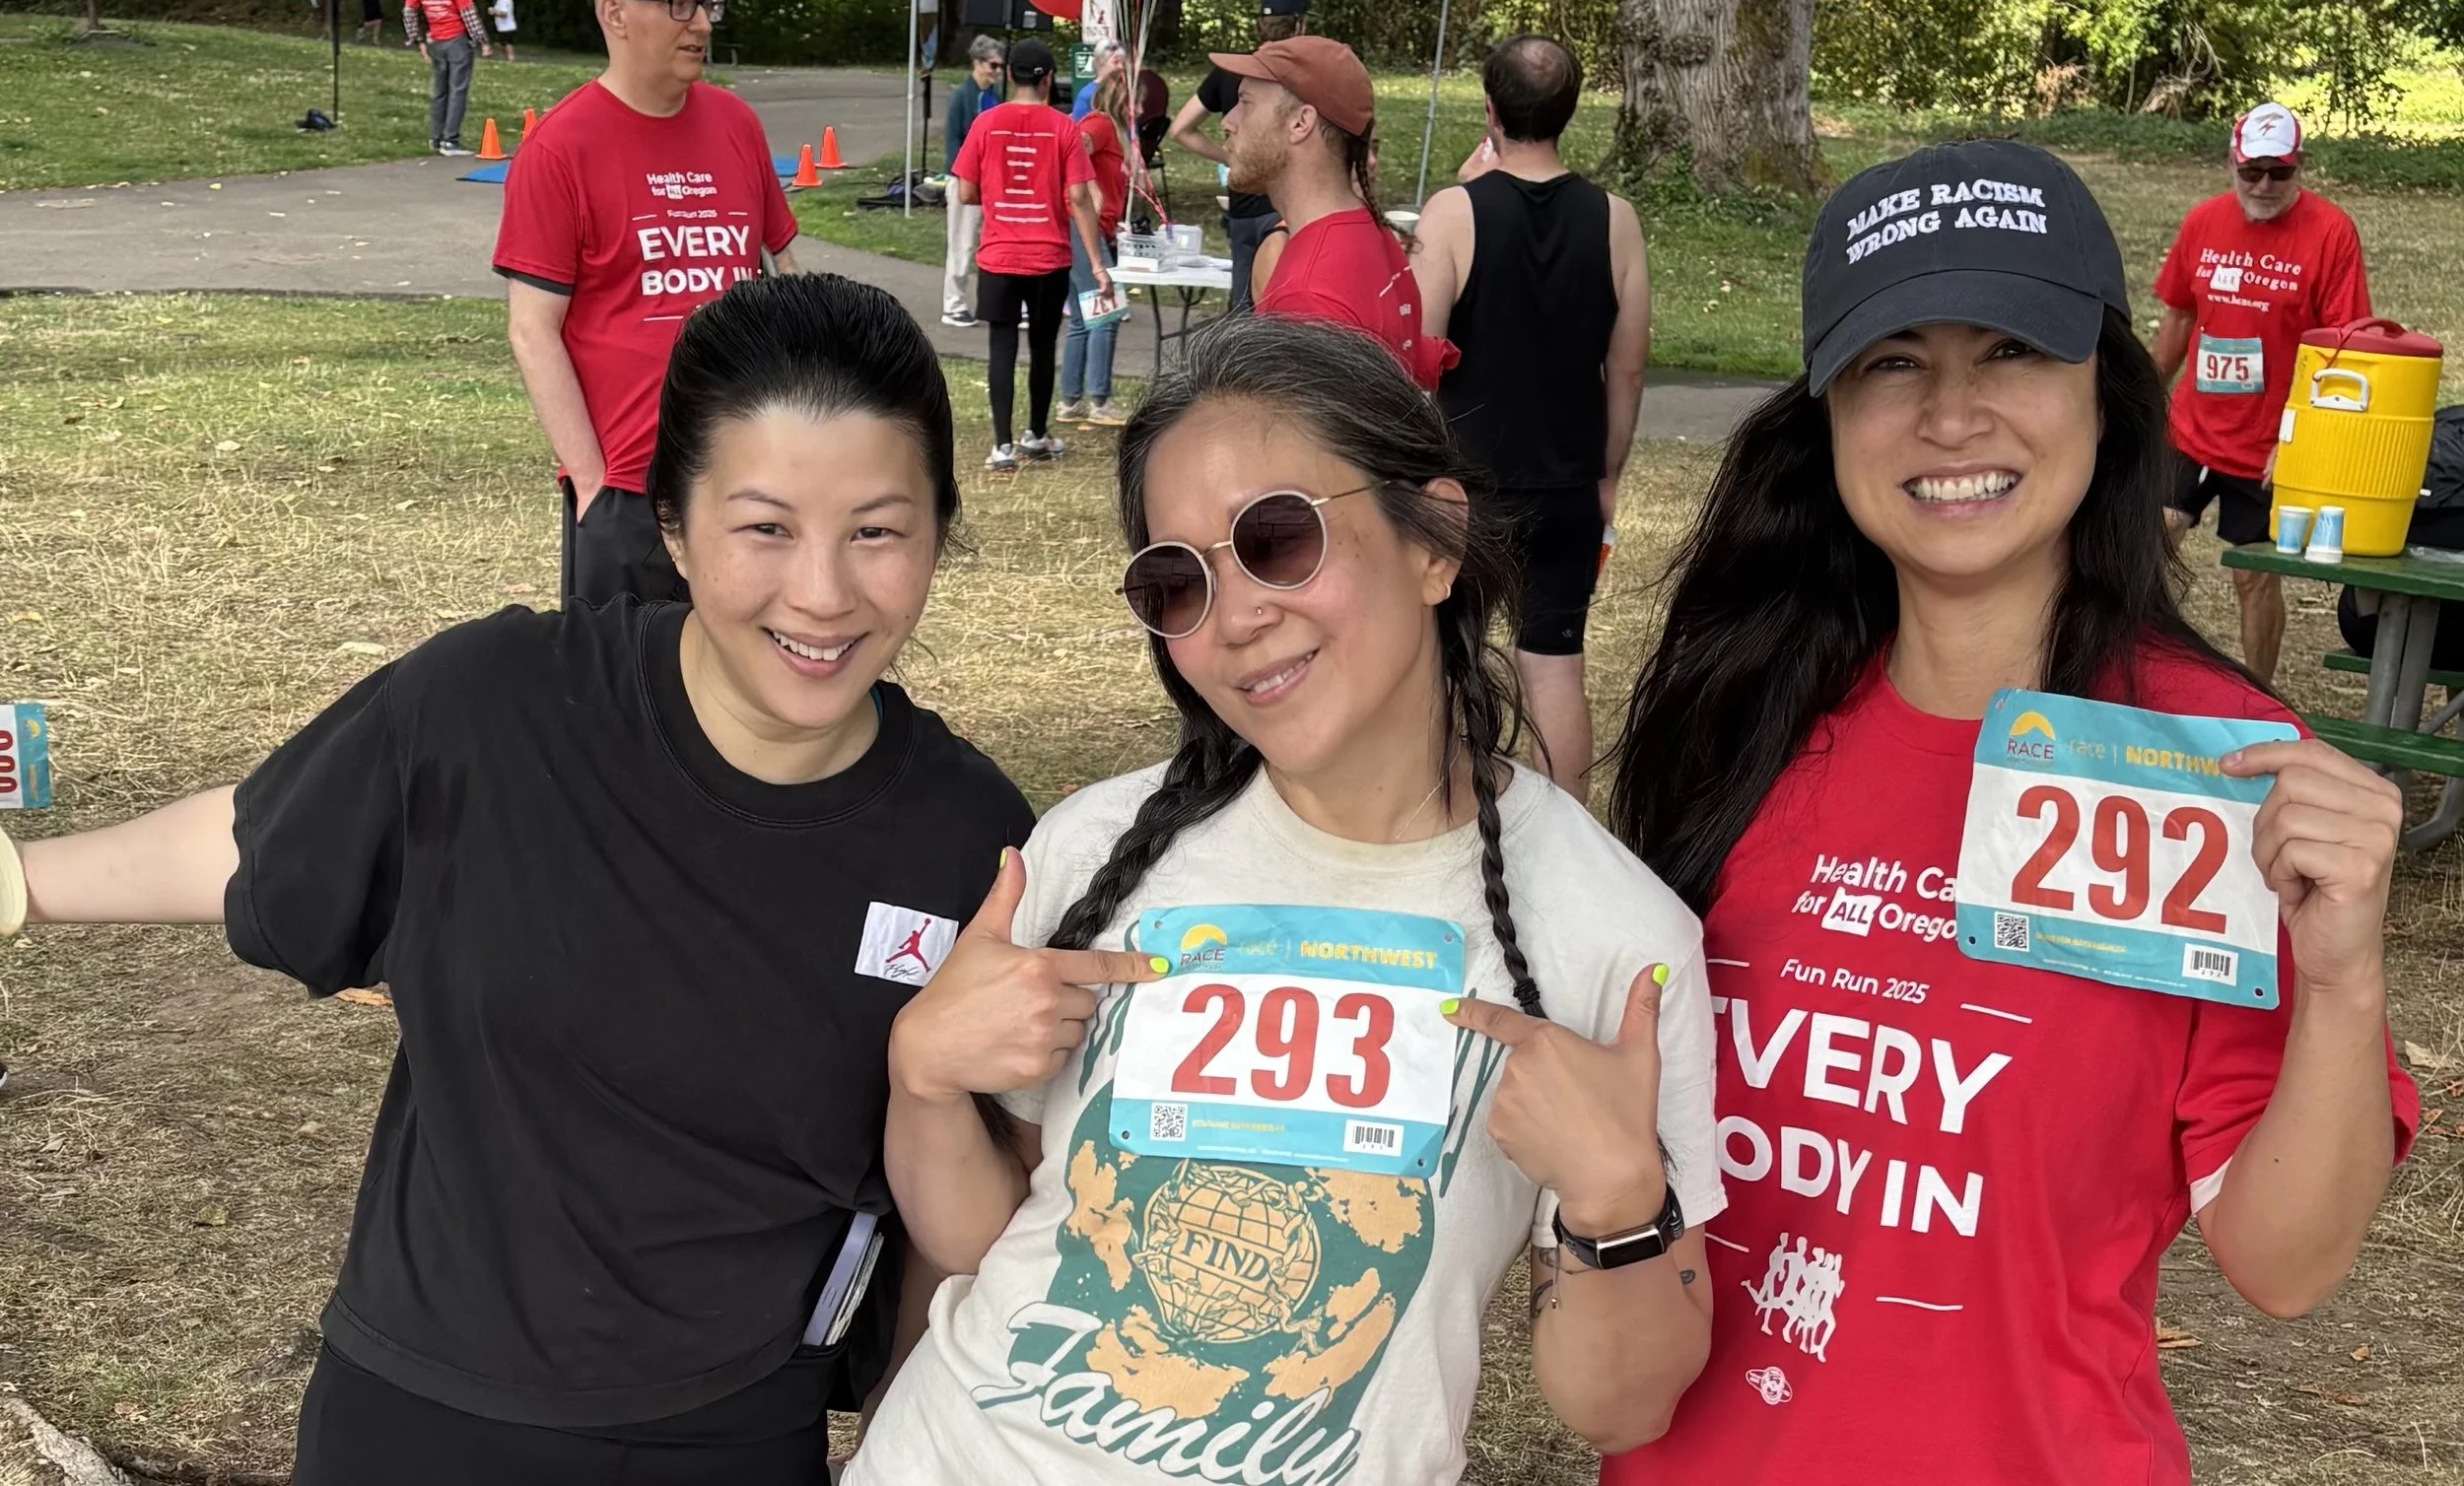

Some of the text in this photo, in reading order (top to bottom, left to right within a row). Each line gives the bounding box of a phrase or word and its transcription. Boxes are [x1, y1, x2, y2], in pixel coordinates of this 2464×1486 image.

[647, 171, 713, 185] Health Care
[1847, 178, 2046, 241] MAKE RACISM
[637, 225, 750, 262] EVERY
[1846, 205, 2048, 265] WRONG AGAIN
[642, 266, 725, 296] BODY
[2200, 247, 2302, 276] Health Care
[2243, 271, 2298, 292] Oregon
[2206, 354, 2249, 381] 975
[2007, 738, 2055, 760] RACE
[2125, 745, 2256, 780] NORTHW
[1810, 853, 1958, 904] Health Ca
[2011, 784, 2229, 935] 292
[1791, 889, 1958, 943] for ALL Orego
[1180, 948, 1227, 967] RACE
[1299, 939, 1438, 971] NORTHWEST
[1780, 958, 1931, 1005] Fun Run 2025
[1170, 982, 1396, 1110] 293
[1711, 995, 2014, 1135] VERY
[1715, 1115, 1985, 1239] ODY IN
[1182, 1229, 1270, 1282] FIND
[970, 1301, 1363, 1486] Family
